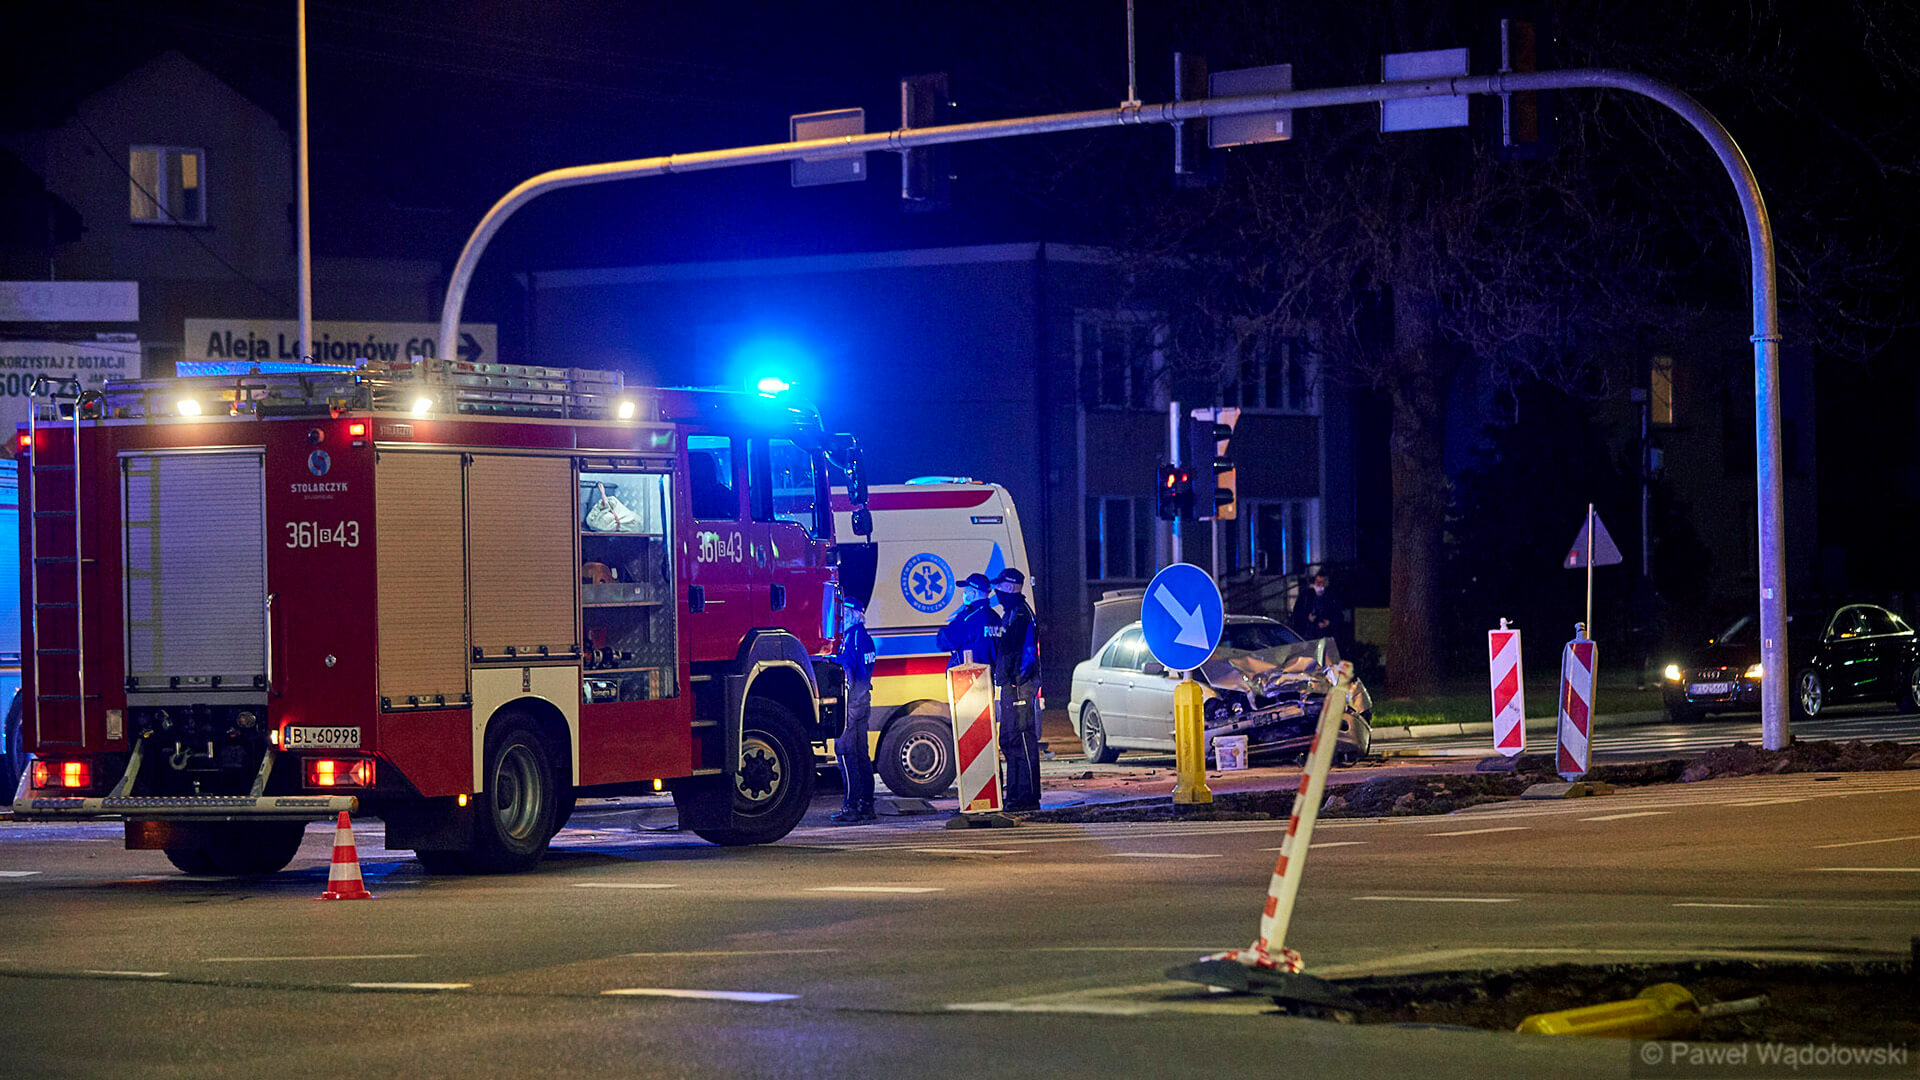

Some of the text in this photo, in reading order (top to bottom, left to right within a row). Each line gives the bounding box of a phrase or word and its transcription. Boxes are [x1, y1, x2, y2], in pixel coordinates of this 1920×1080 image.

[206, 330, 271, 360] Aleja
[405, 337, 435, 358] 60
[0, 356, 126, 369] KORZYSTAJ Z DOTACJI
[290, 482, 348, 493] STOLARCZYK
